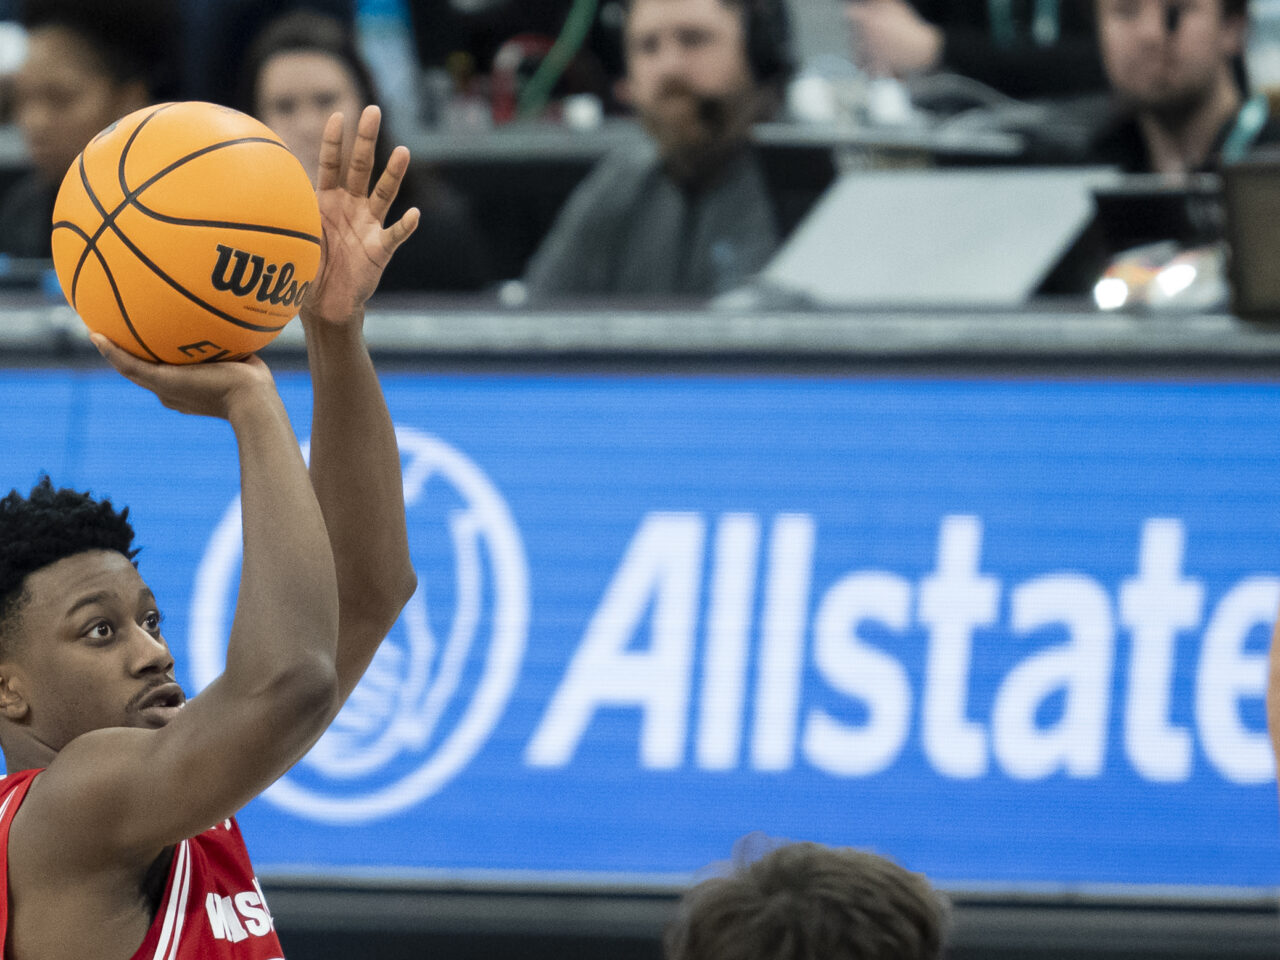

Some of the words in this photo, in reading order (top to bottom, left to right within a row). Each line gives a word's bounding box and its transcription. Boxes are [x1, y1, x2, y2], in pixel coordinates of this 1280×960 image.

[211, 244, 309, 307] Wilso
[526, 511, 1279, 784] Allstate
[205, 878, 274, 943] WIS
